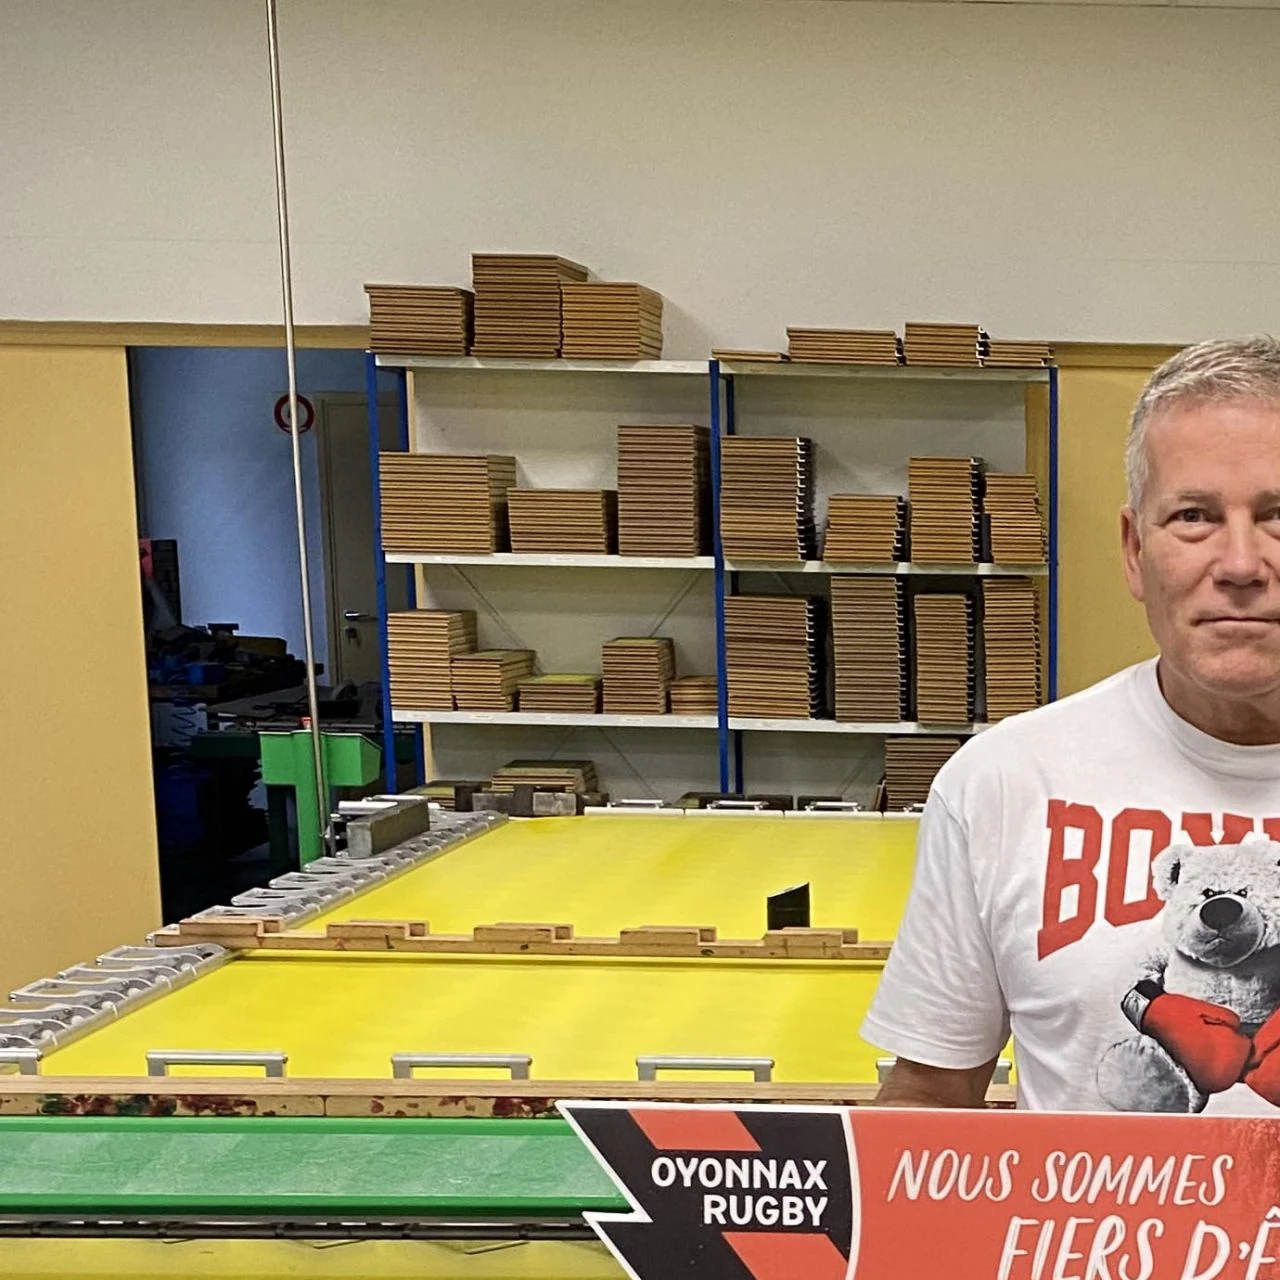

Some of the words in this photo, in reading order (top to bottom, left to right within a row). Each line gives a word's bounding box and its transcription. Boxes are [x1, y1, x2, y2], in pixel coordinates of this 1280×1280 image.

[650, 1156, 829, 1190] OYONNAX
[886, 1148, 1020, 1202] NOUS
[1031, 1150, 1234, 1206] SOMMES
[703, 1194, 829, 1226] RUGBY
